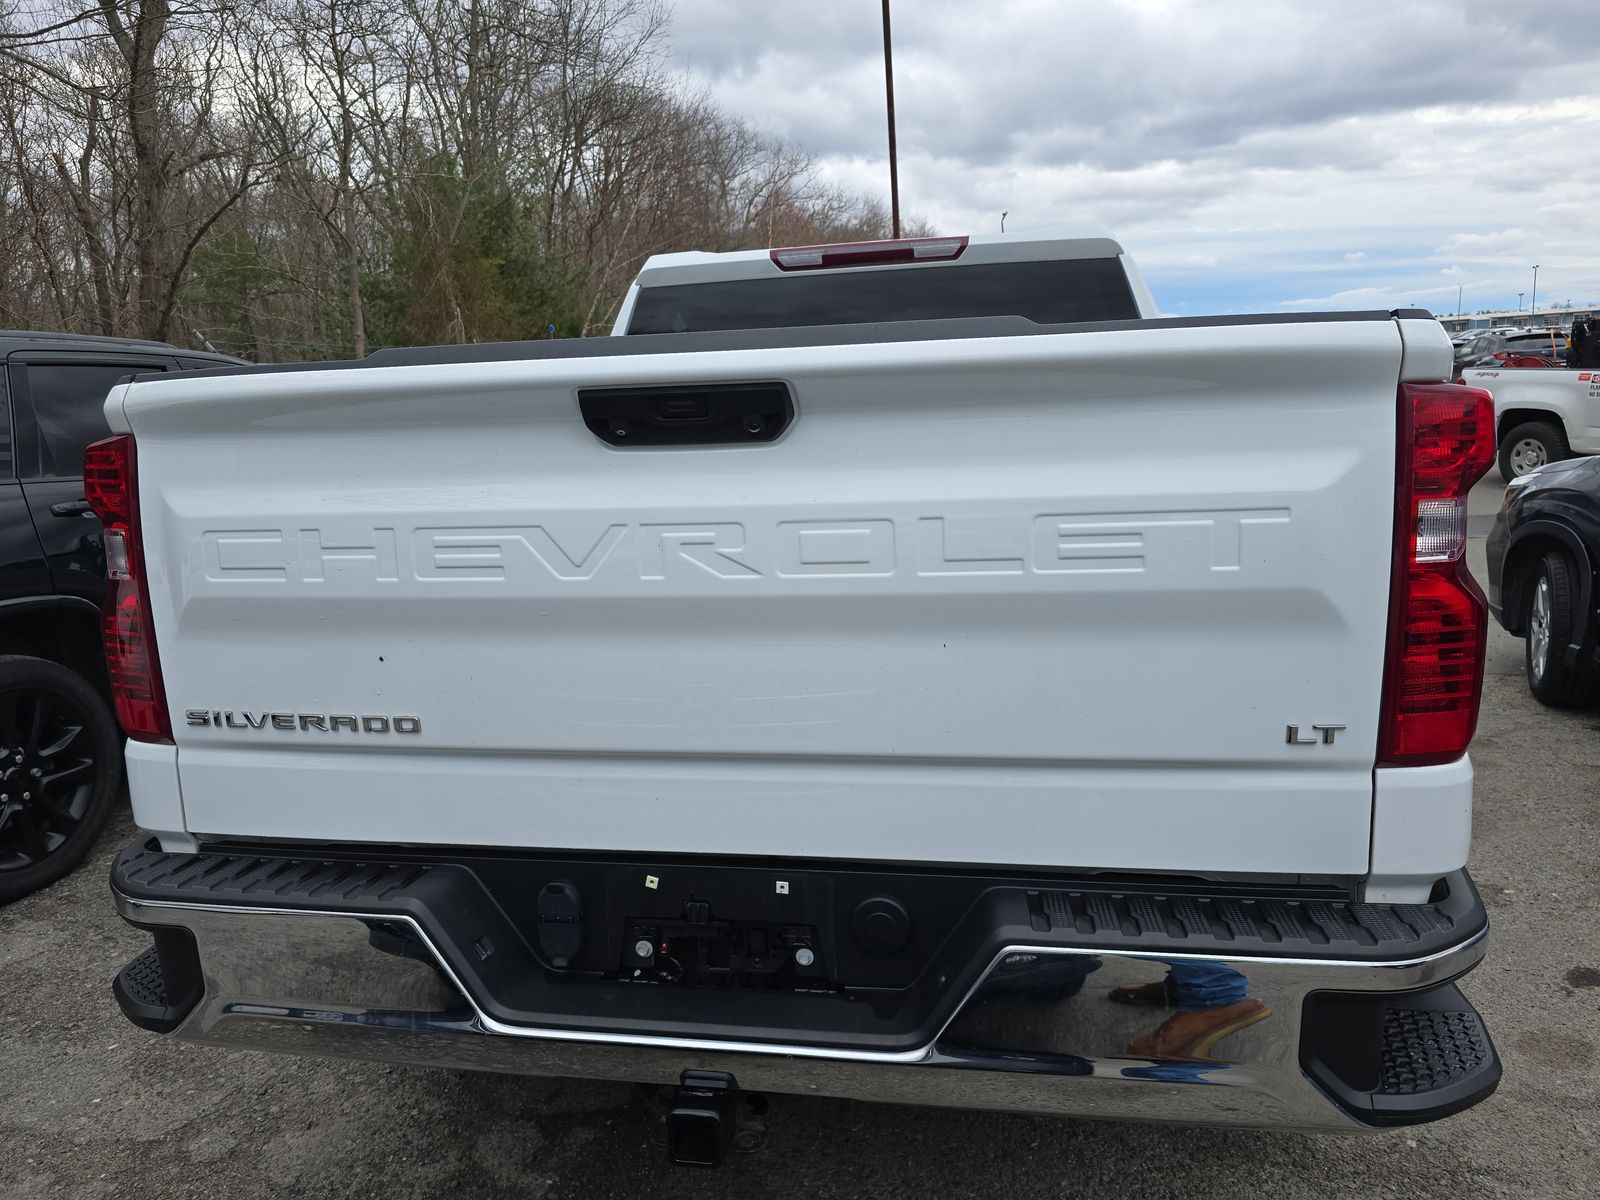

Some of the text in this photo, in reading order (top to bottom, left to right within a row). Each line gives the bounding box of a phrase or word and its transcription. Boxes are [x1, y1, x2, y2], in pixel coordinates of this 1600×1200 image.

[201, 506, 1290, 582] CHEVROLET
[185, 709, 421, 734] SILVERADO
[1286, 724, 1346, 744] LT
